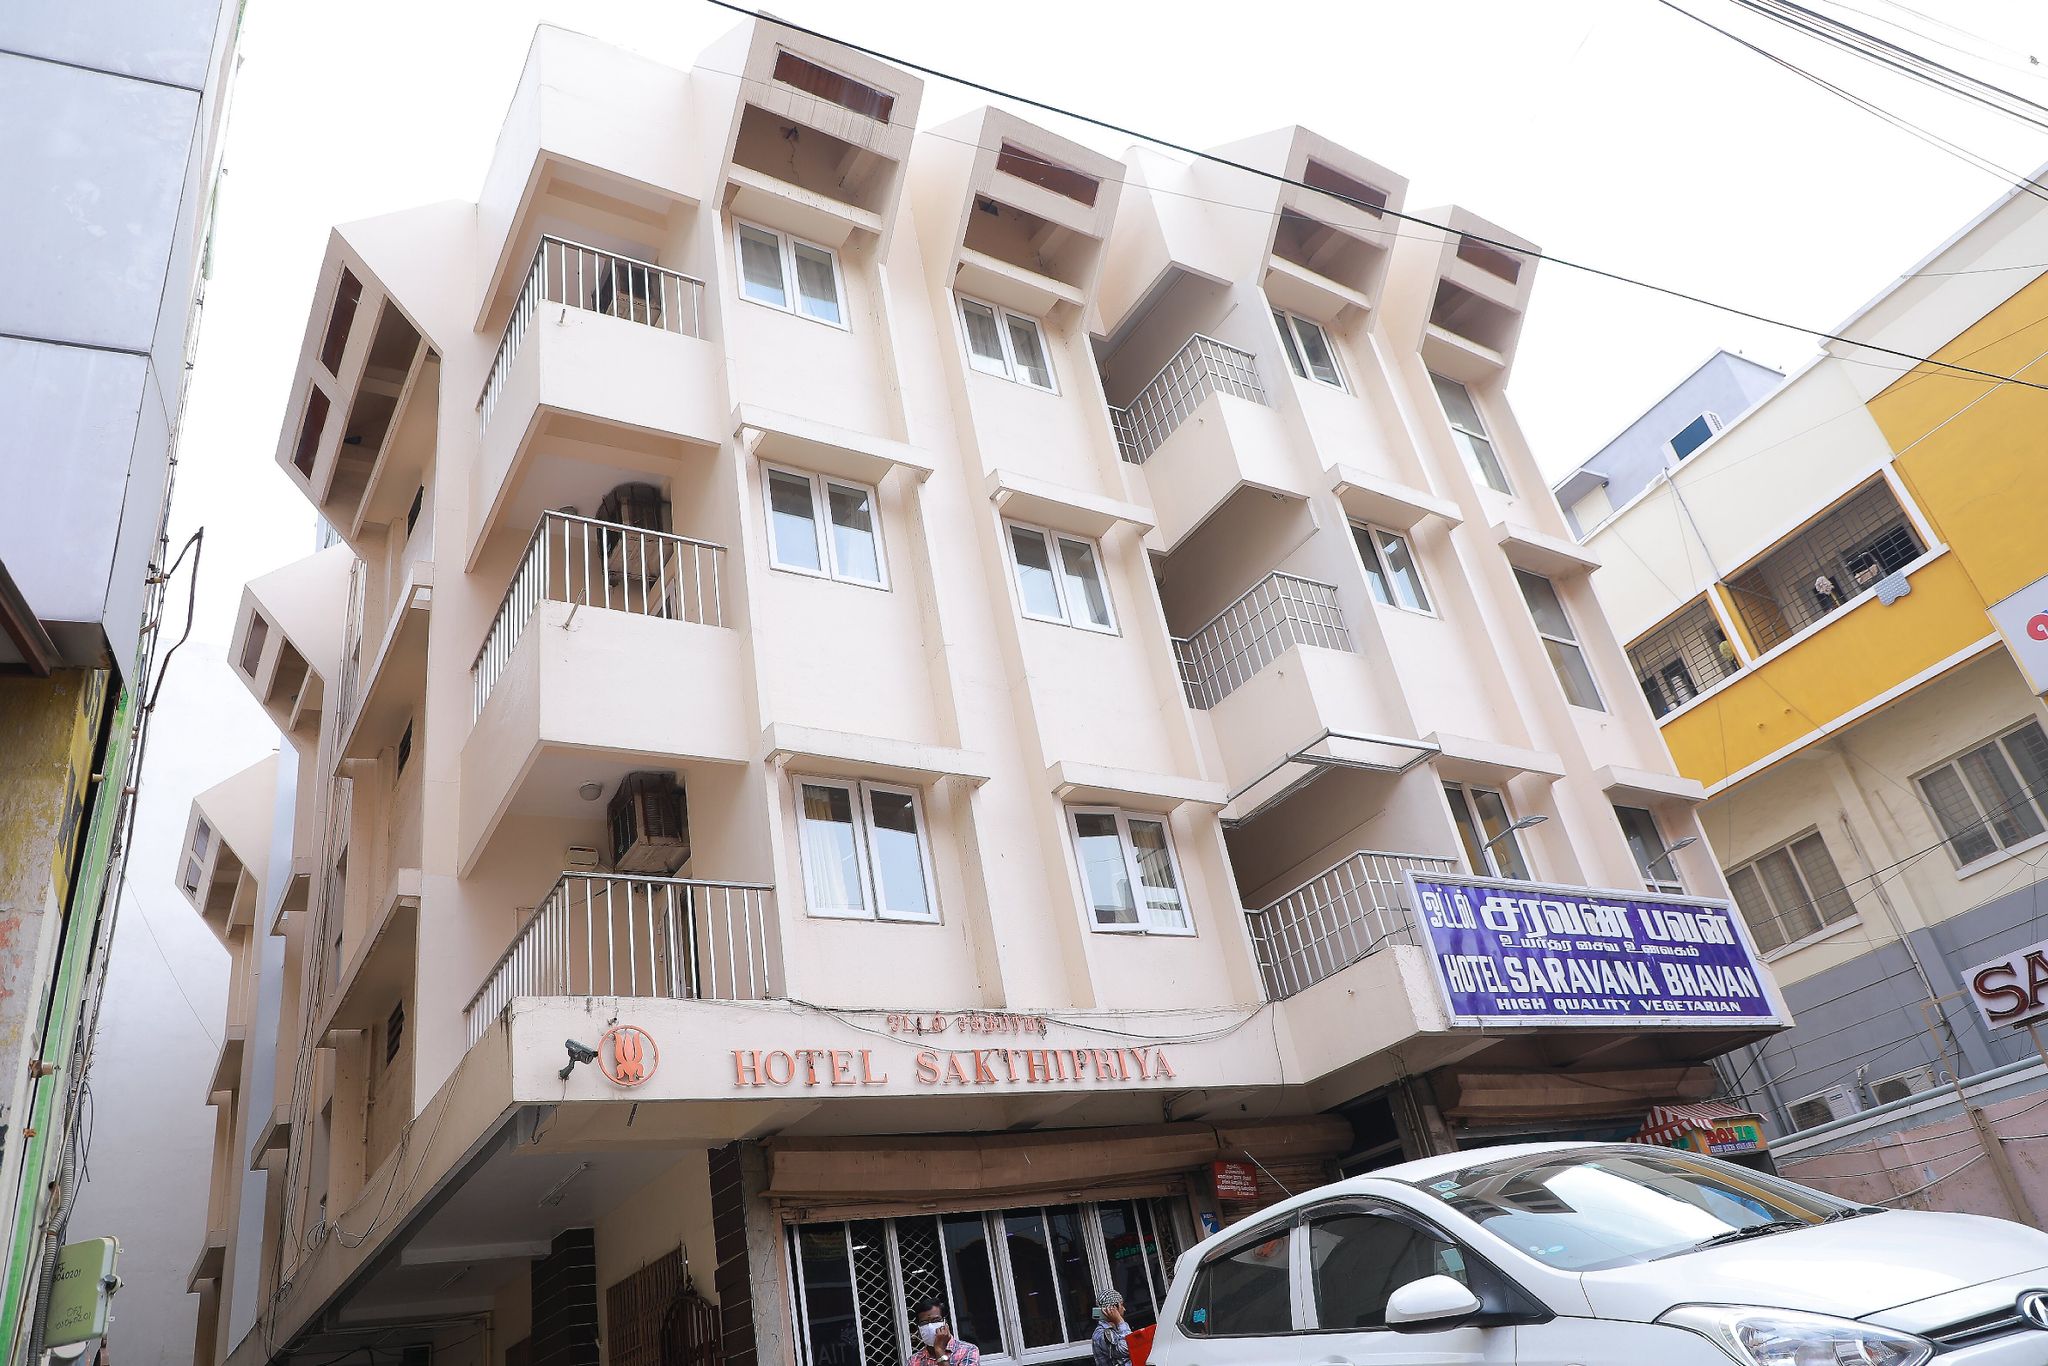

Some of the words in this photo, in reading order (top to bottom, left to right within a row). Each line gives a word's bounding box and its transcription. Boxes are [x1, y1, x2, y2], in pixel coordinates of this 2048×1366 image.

[1637, 908, 1736, 945] பவன்
[1499, 934, 1571, 952] உயர்தர
[1577, 940, 1620, 952] சைவ
[1624, 941, 1700, 957] உணவகம்
[1443, 954, 1510, 993] HOTEL
[1503, 956, 1661, 995] SARAVANA
[1660, 962, 1760, 998] BHAVAN
[1495, 998, 1547, 1010] HIGH
[1553, 998, 1631, 1014] QUALITY
[1639, 1000, 1742, 1012] VEGETARIAN
[731, 1049, 888, 1087] HOTEL
[915, 1049, 1177, 1086] SAKTHIPRIYA
